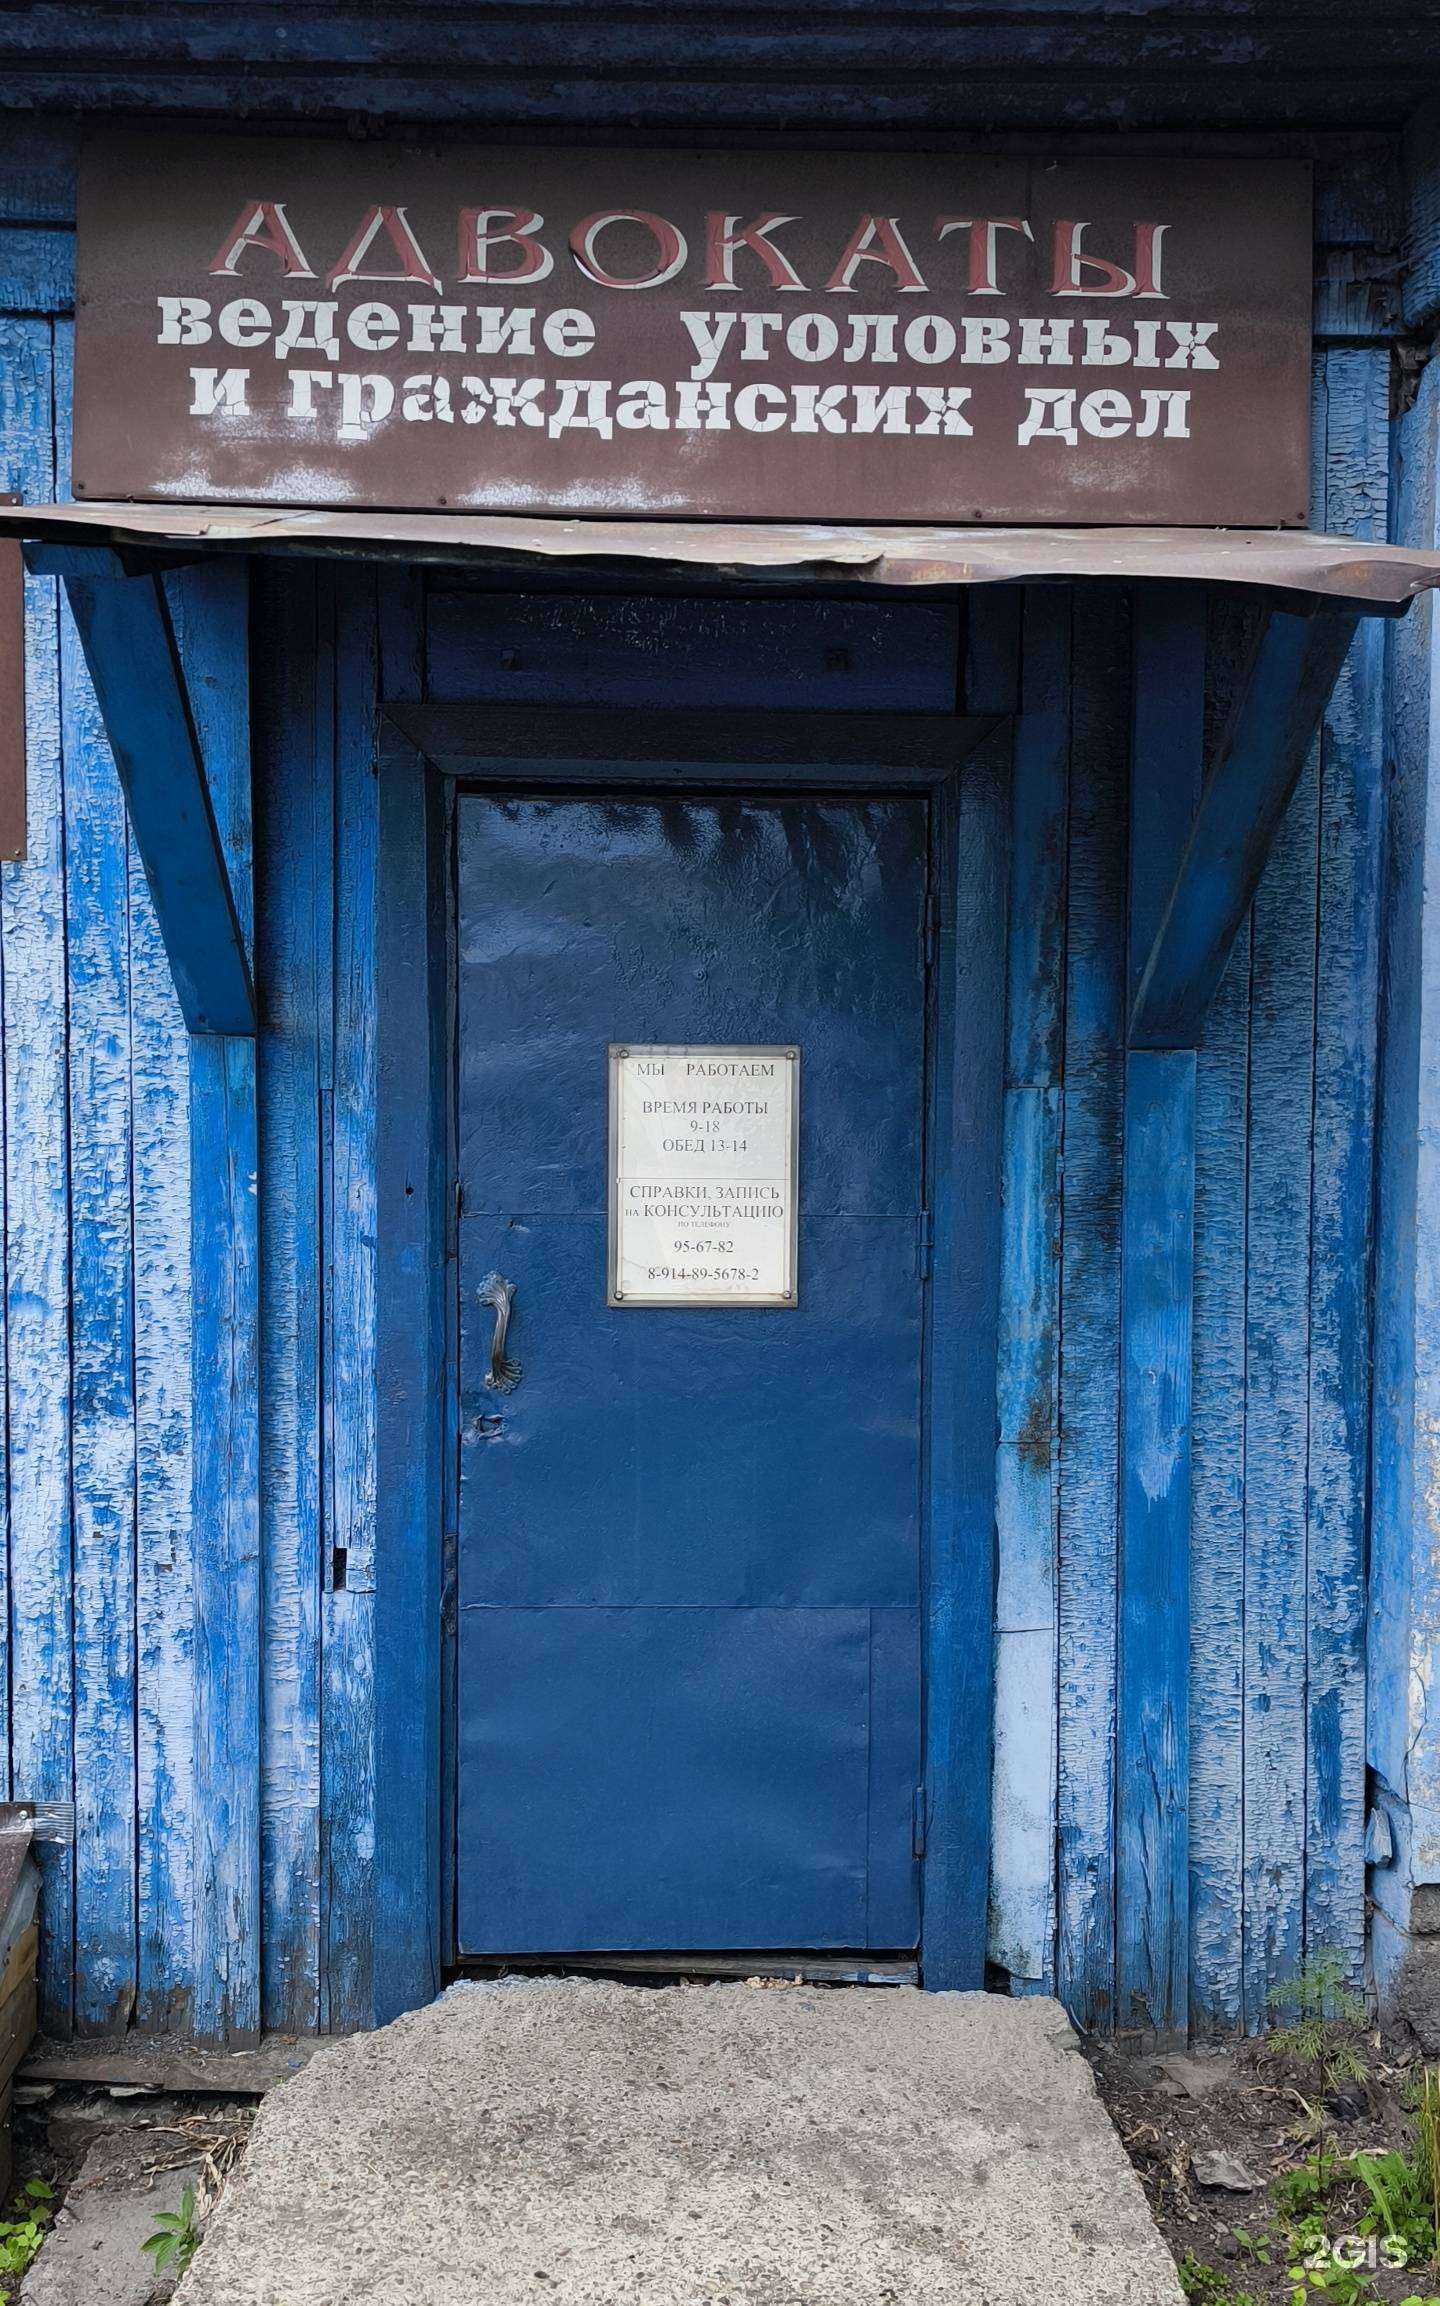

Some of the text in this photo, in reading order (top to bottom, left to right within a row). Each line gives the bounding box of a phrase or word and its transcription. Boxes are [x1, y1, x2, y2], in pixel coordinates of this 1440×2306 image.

[207, 200, 1173, 300] АДВОКАТЫ
[157, 296, 1221, 382] ведение уголовных
[189, 368, 1192, 446] и гражданских дел
[636, 1063, 775, 1077] МЫ РАБОТАЕМ
[642, 1101, 768, 1114] ВРЕМЯ РАБОТЫ
[689, 1119, 720, 1132] 9-18
[662, 1138, 748, 1153] ОБЕД 13-14
[715, 1186, 780, 1199] ЗАПИСЬ
[643, 1204, 784, 1219] КОНСУЛЬТАЦИЮ
[673, 1240, 734, 1253] 95-67-82
[647, 1267, 760, 1281] 8-914-89-5678-2
